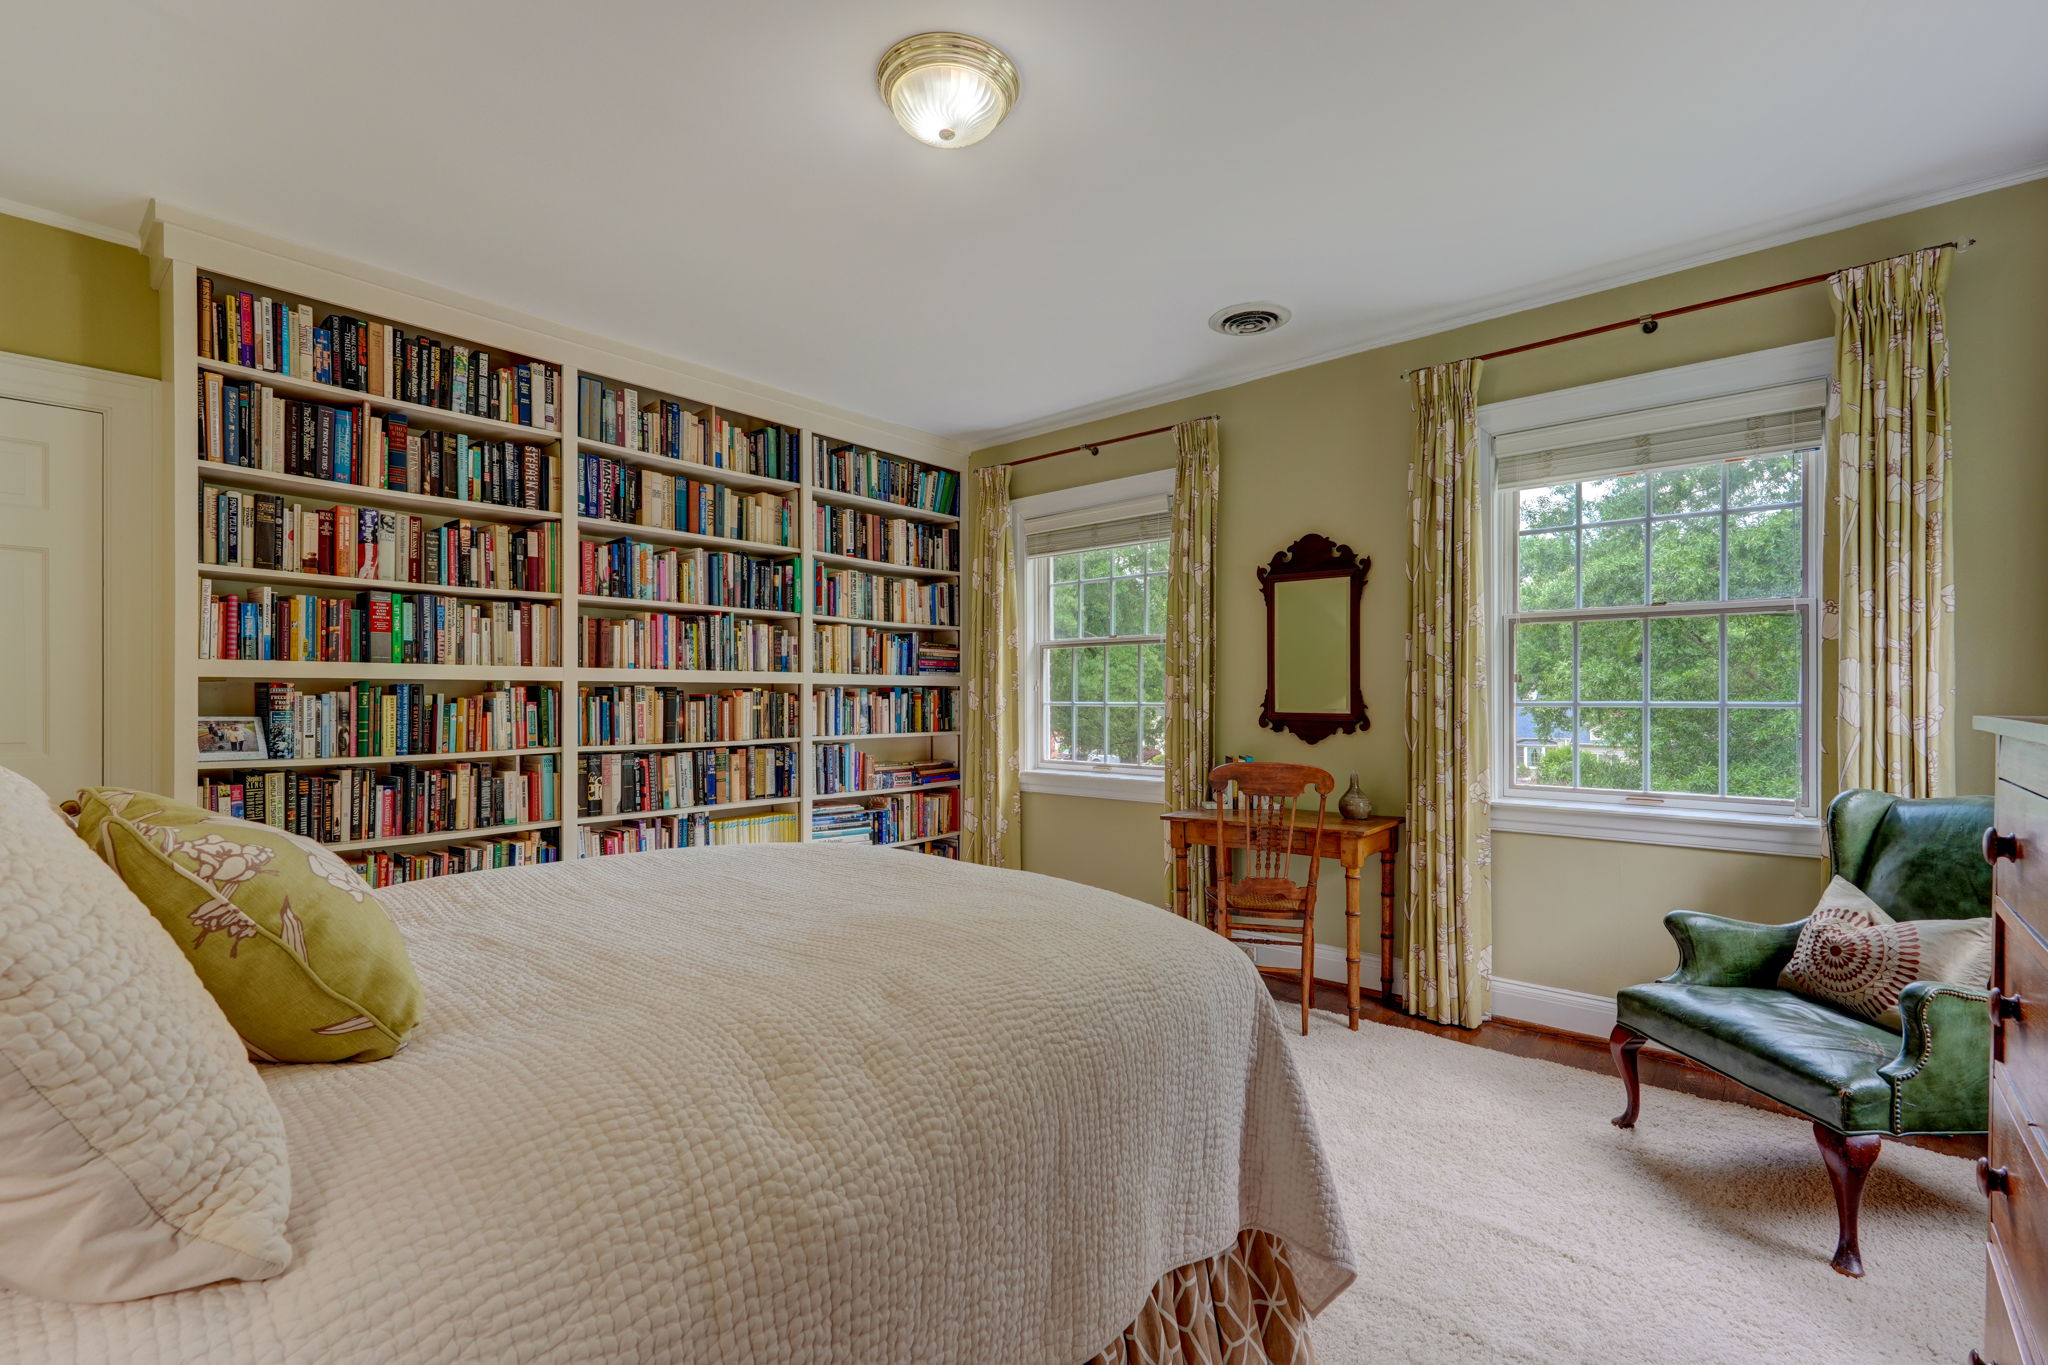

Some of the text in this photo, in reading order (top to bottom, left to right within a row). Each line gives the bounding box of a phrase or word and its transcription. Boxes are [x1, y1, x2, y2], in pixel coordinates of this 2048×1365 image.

[411, 346, 419, 357] The
[322, 446, 329, 455] OF
[409, 445, 418, 472] TITAN
[321, 456, 329, 471] TIDES
[525, 446, 536, 488] STEPHEN
[603, 460, 611, 520] MARSHALL
[461, 534, 471, 555] Alibi
[288, 775, 296, 809] FLESH
